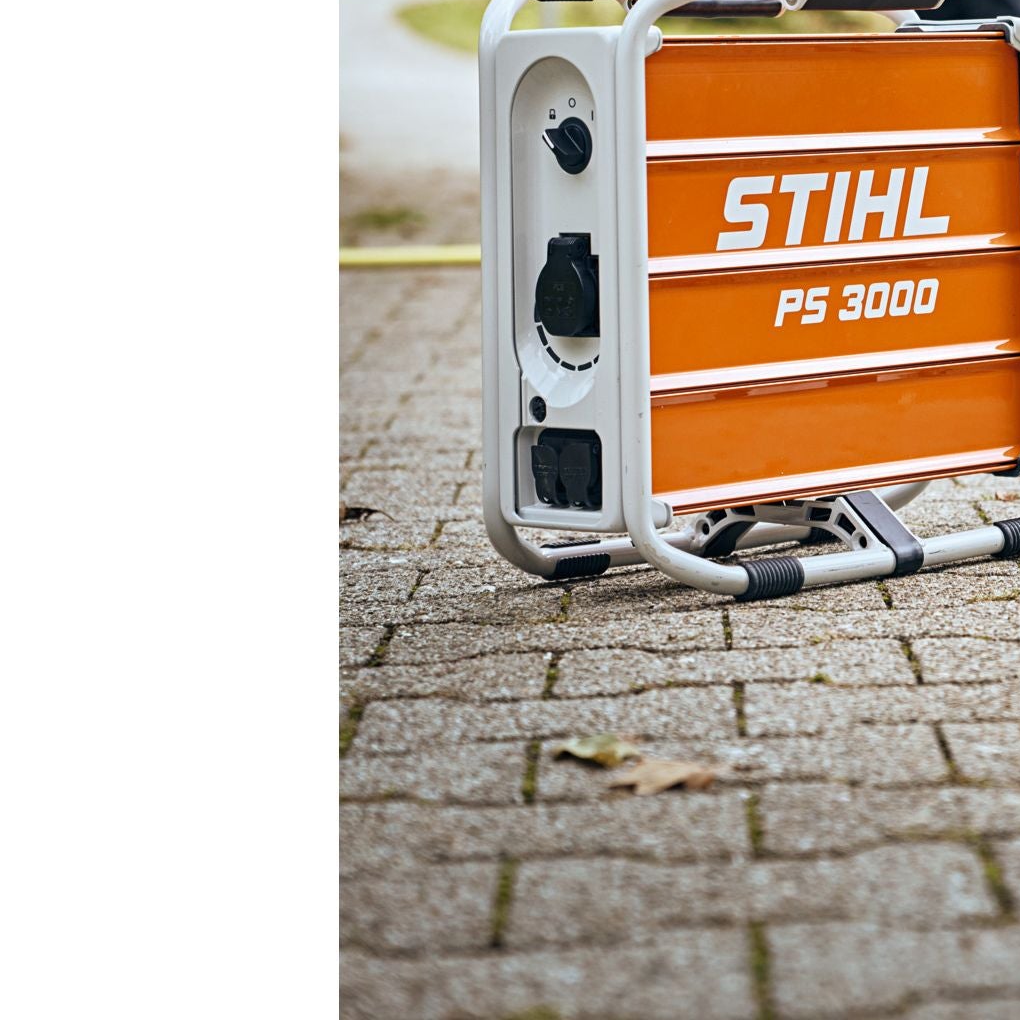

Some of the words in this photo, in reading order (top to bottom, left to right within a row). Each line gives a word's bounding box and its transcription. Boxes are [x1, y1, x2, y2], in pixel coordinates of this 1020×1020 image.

[716, 167, 950, 251] STIHL
[774, 286, 830, 327] PS
[838, 278, 940, 321] 3000
